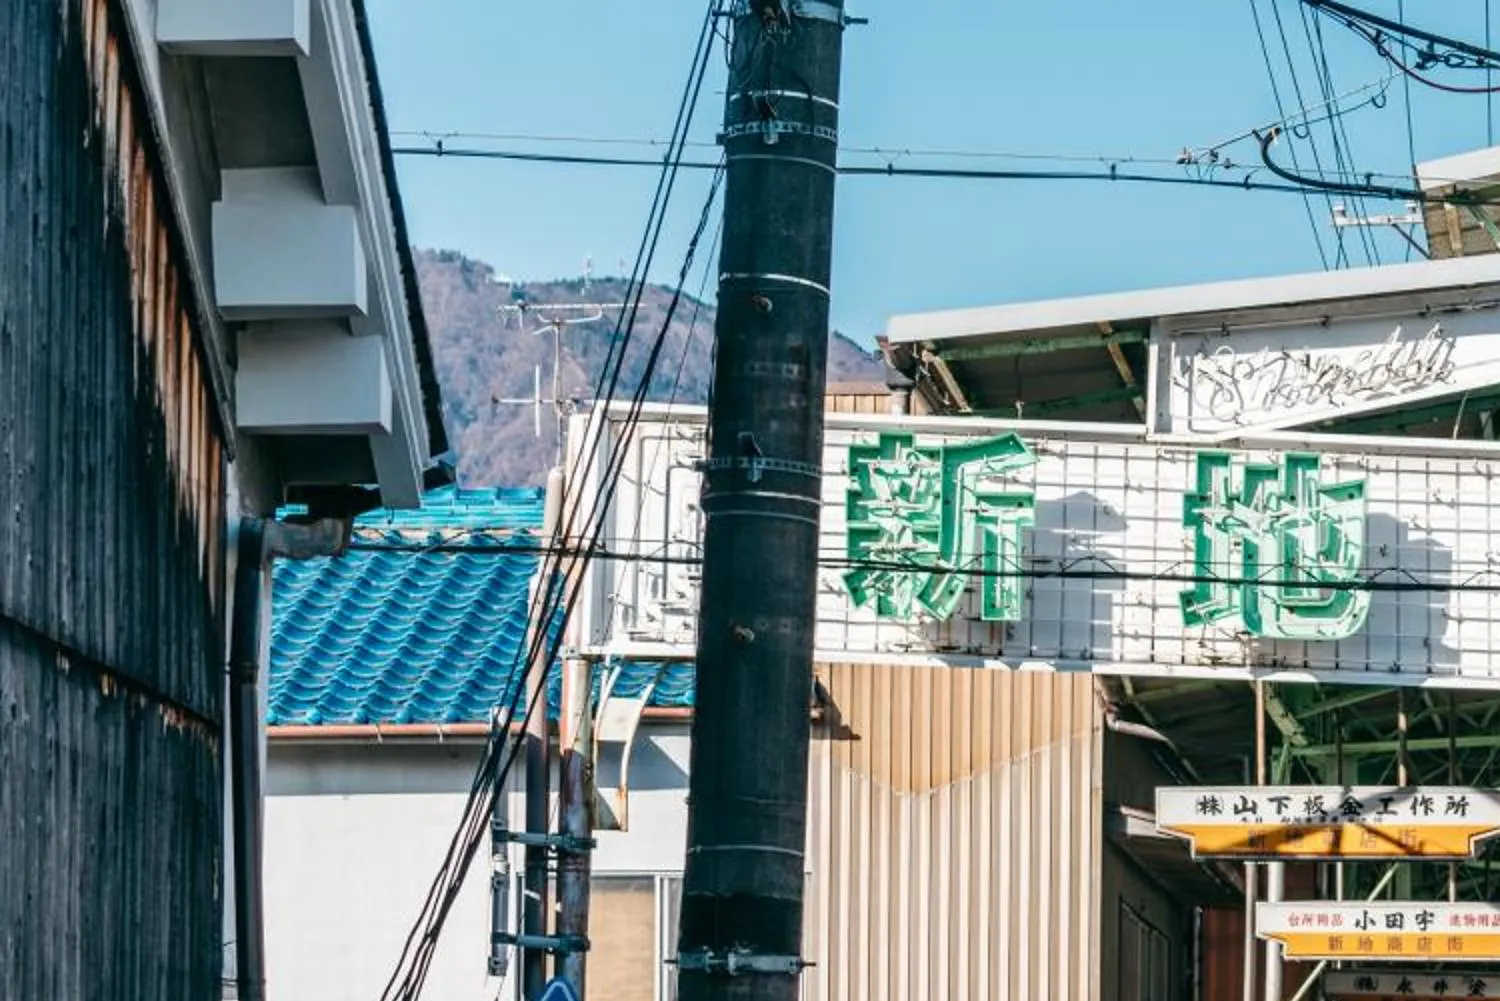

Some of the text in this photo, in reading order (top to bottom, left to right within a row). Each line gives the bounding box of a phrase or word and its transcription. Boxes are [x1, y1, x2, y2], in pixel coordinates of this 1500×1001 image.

[1328, 935, 1463, 953] 新地商店街
